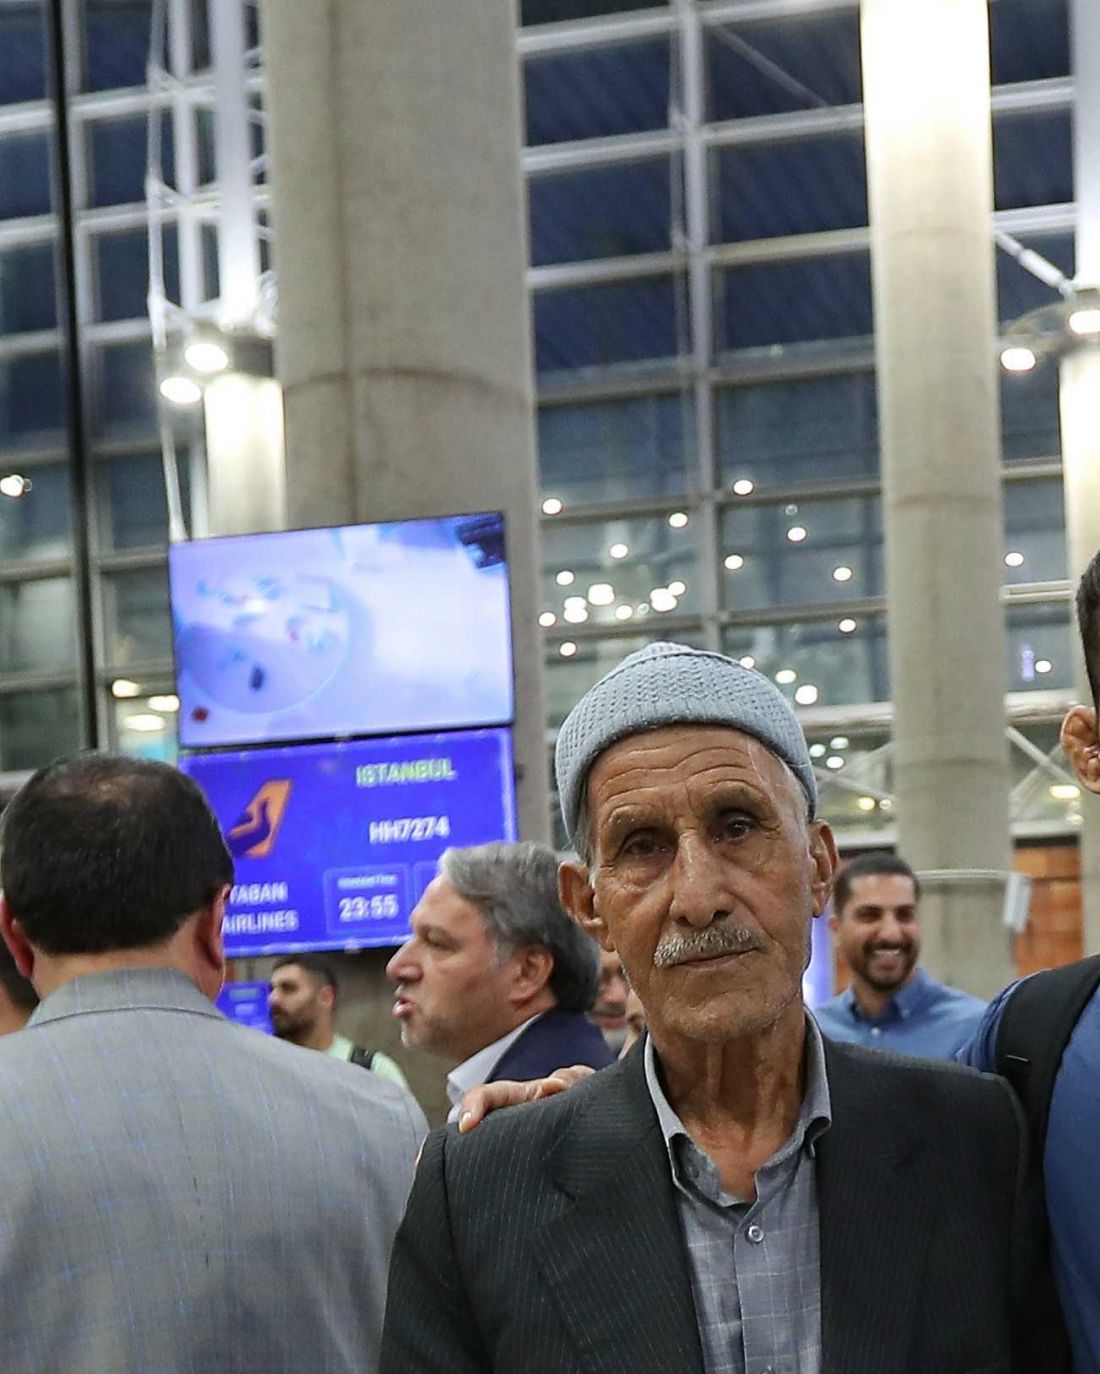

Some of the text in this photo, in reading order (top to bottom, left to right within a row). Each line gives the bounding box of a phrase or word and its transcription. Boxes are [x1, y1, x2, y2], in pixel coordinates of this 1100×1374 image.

[356, 758, 457, 787] ISTANBUL
[369, 816, 450, 844] HH7274
[222, 909, 300, 934] AIRLINES
[339, 894, 400, 922] 23:55
